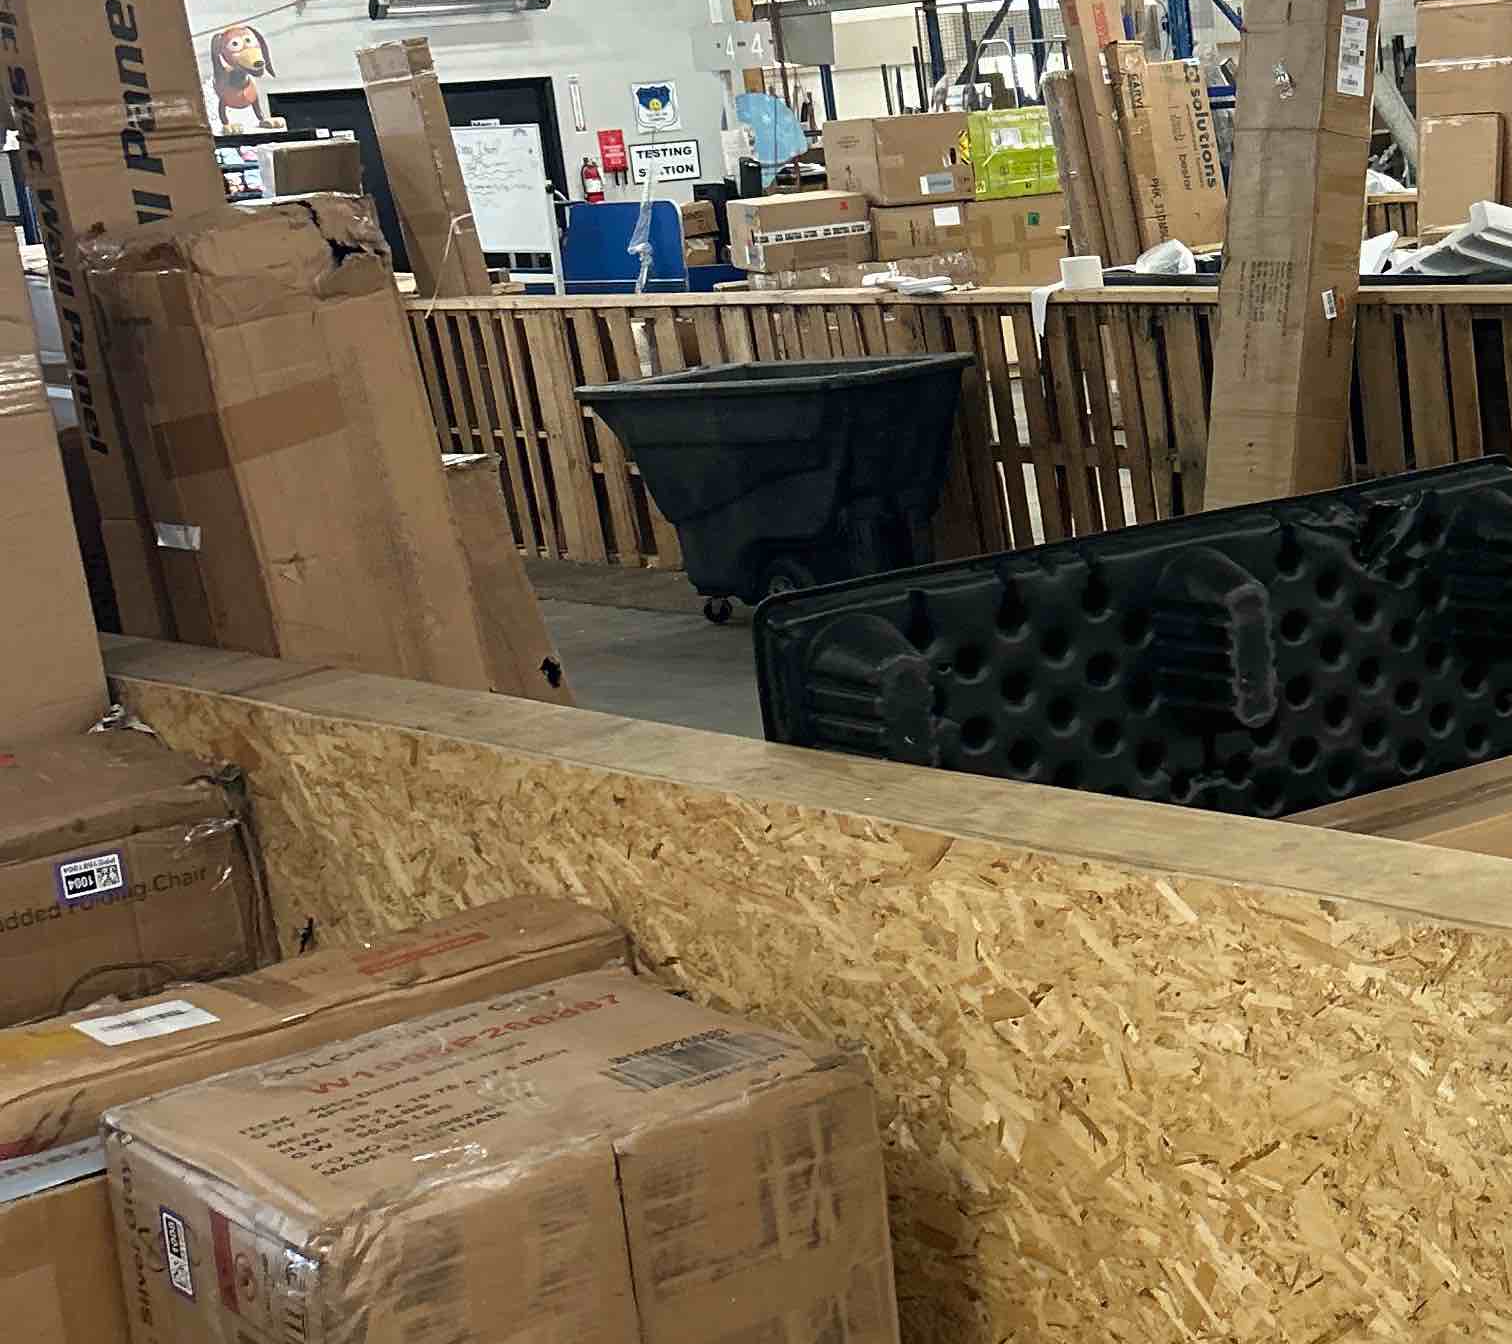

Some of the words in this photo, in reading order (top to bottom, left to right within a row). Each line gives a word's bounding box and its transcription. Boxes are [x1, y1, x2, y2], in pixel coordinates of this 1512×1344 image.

[1190, 88, 1216, 187] solutions
[636, 146, 692, 159] TESTING
[638, 164, 694, 178] STION
[64, 310, 107, 456] Panel
[152, 867, 208, 893] Chair
